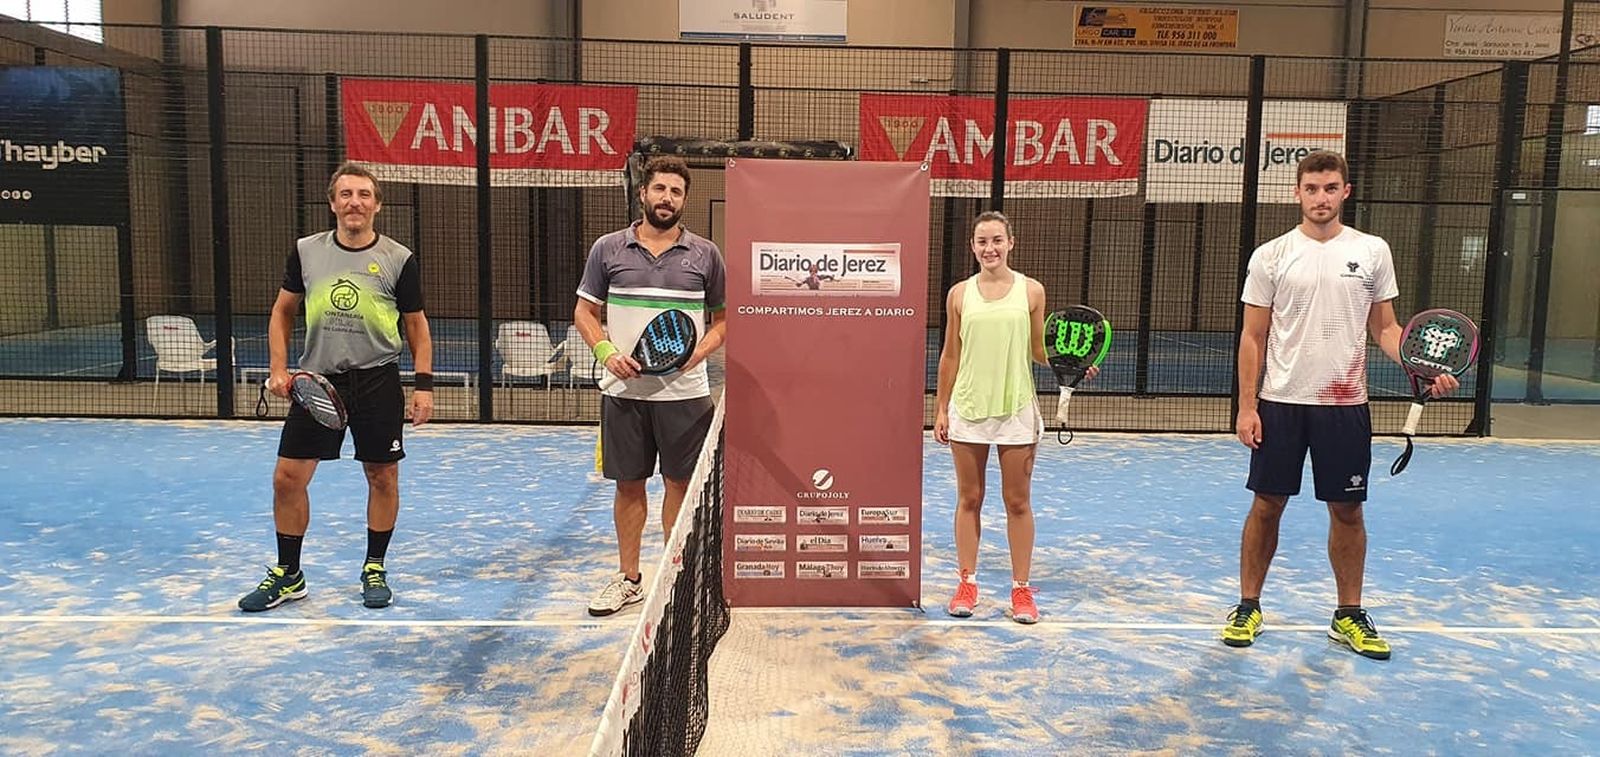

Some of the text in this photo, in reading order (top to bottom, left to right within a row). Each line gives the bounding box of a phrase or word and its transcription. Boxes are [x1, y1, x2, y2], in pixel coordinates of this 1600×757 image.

[733, 12, 795, 20] SALUDENT
[1171, 31, 1186, 40] 956
[1187, 31, 1201, 40] 311
[1202, 32, 1218, 40] 000
[411, 102, 618, 155] AMBAR
[924, 116, 1123, 167] AMBAR
[1154, 138, 1322, 171] Diario d Jere
[760, 253, 886, 277] Diario de Jerez
[737, 306, 915, 317] COMPARTIMOS JEREZ A DIARIO
